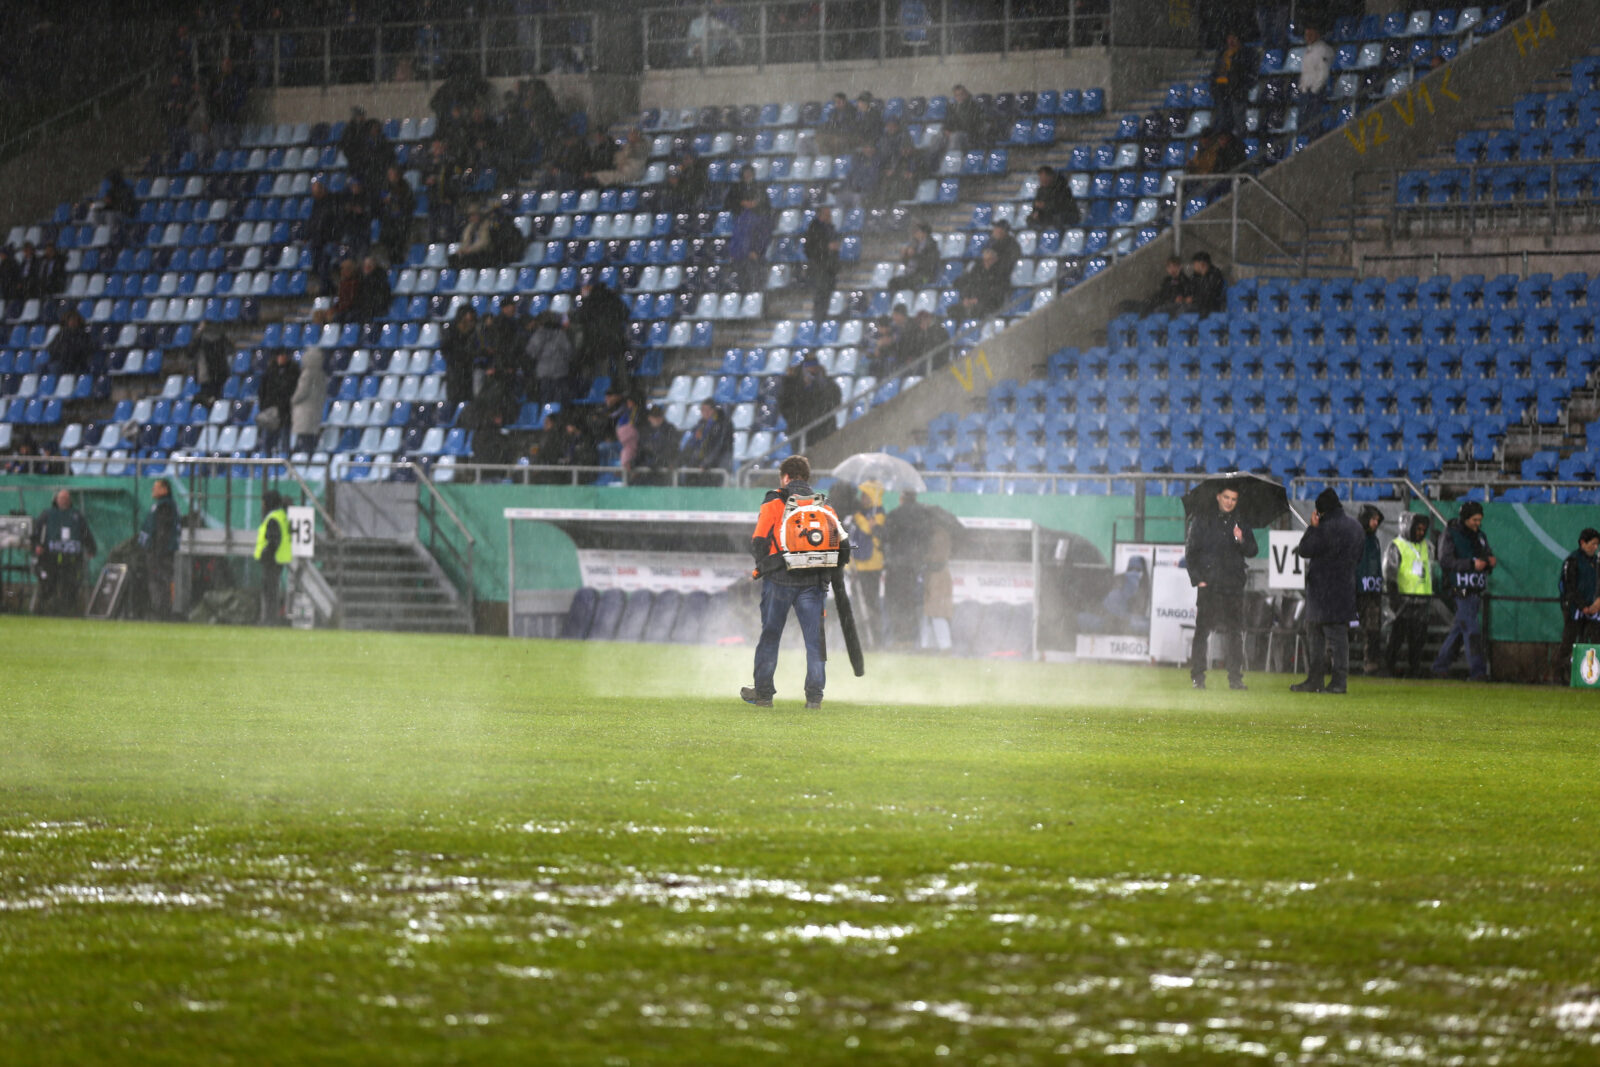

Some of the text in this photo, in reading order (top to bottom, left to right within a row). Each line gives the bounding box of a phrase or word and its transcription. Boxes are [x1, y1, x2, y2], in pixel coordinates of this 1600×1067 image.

[1512, 9, 1557, 57] H4
[1344, 82, 1435, 155] V2 V1
[949, 350, 993, 393] V1
[1272, 545, 1303, 575] V1
[1156, 608, 1190, 619] TARGO
[1110, 641, 1143, 655] TARGO
